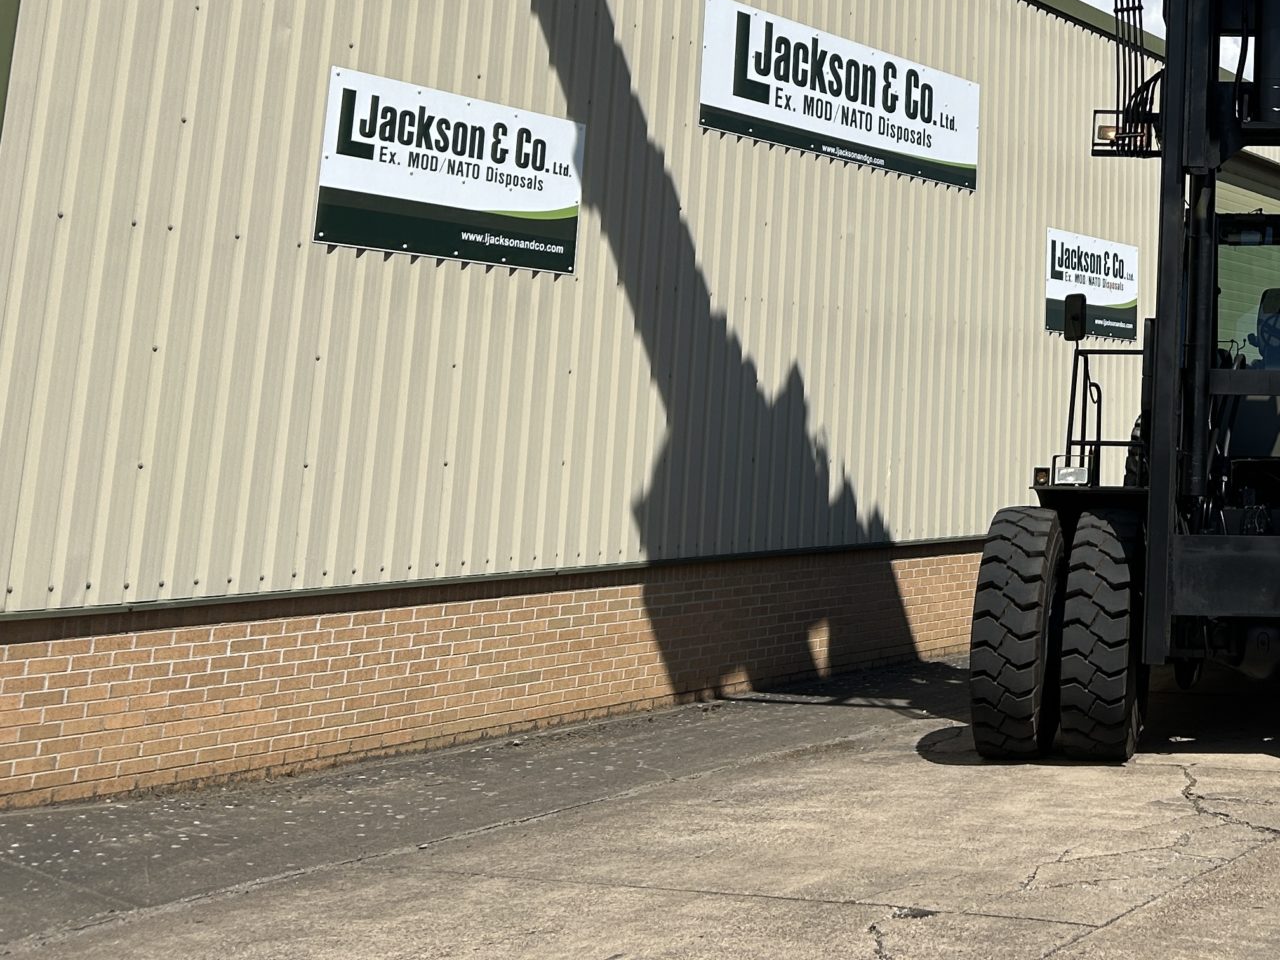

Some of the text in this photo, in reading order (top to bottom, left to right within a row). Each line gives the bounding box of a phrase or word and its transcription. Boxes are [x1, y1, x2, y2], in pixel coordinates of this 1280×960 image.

[775, 87, 796, 112] Ex.
[878, 115, 932, 148] Disposals
[882, 61, 899, 113] &
[905, 69, 937, 125] Co.
[940, 112, 958, 132] Ltd.
[379, 146, 401, 166] Ex.
[486, 166, 544, 191] Disposals
[491, 122, 509, 164] &
[515, 127, 550, 173] Co.
[552, 161, 572, 178] Ltd.
[461, 230, 564, 254] www.ljacksonandco.com
[1104, 251, 1110, 277] &
[1113, 253, 1126, 280] Co.
